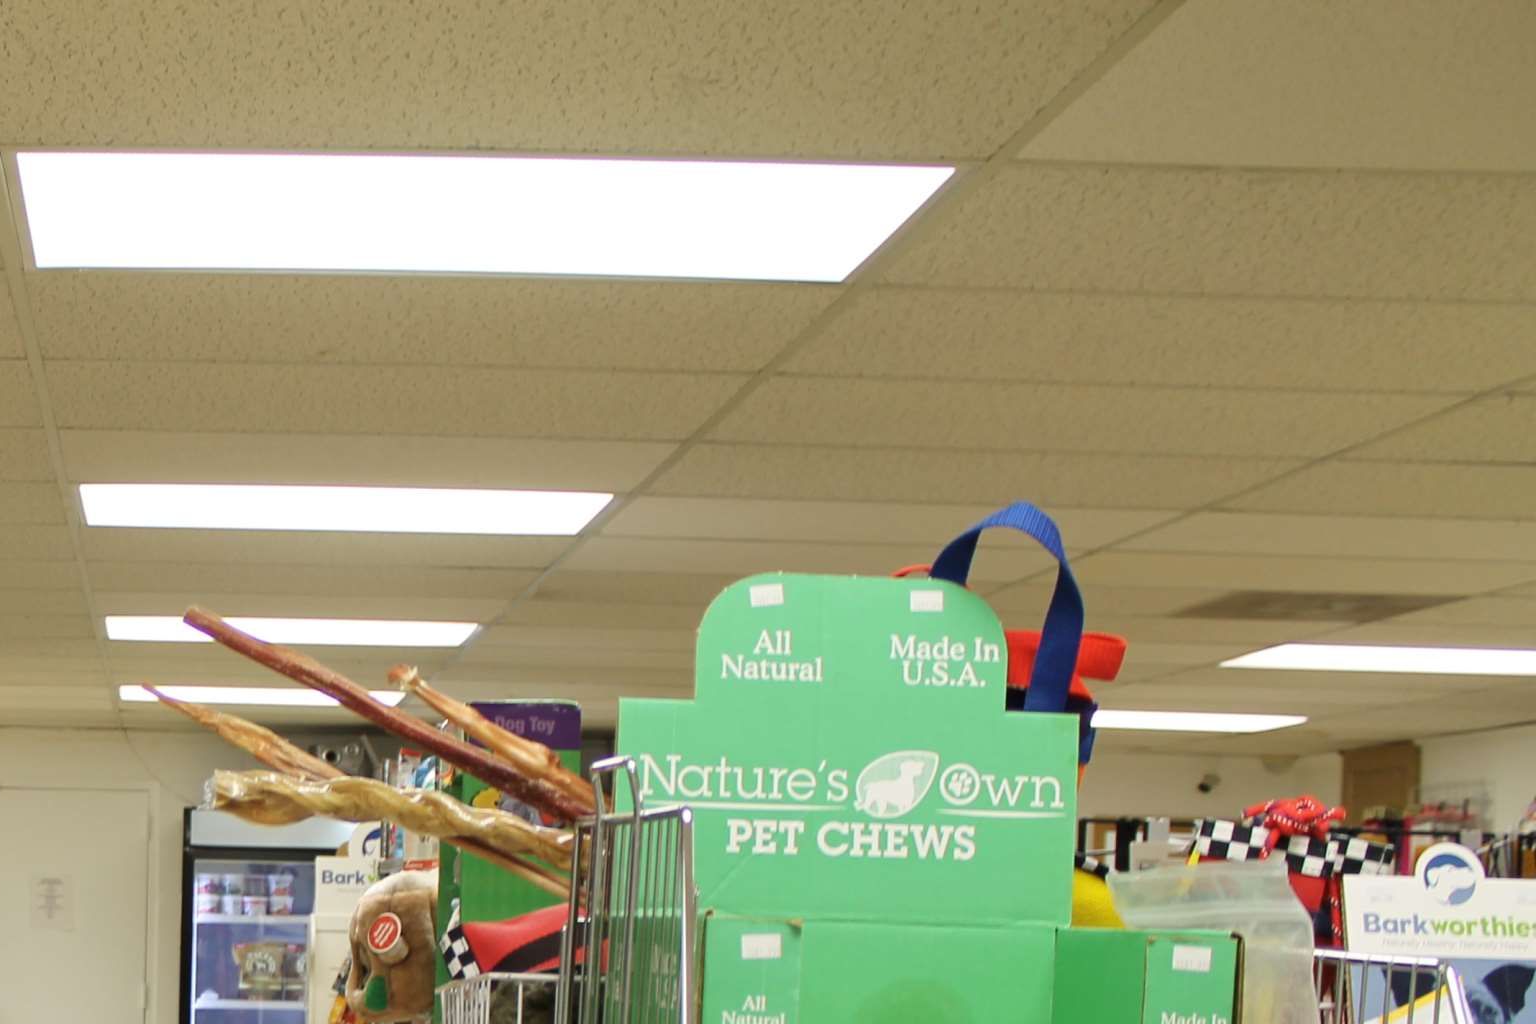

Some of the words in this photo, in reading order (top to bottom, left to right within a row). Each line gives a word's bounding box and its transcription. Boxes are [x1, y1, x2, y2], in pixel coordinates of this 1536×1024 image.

[753, 629, 792, 656] All
[889, 633, 965, 661] Made
[972, 637, 1001, 663] In
[720, 654, 824, 682] Natural
[902, 660, 987, 688] U.S.A.
[528, 715, 556, 736] Toy
[638, 753, 849, 802] Nature's
[939, 761, 1065, 809] Own
[725, 818, 805, 856] PET
[816, 820, 976, 861] CHEWS
[741, 994, 767, 1012] All
